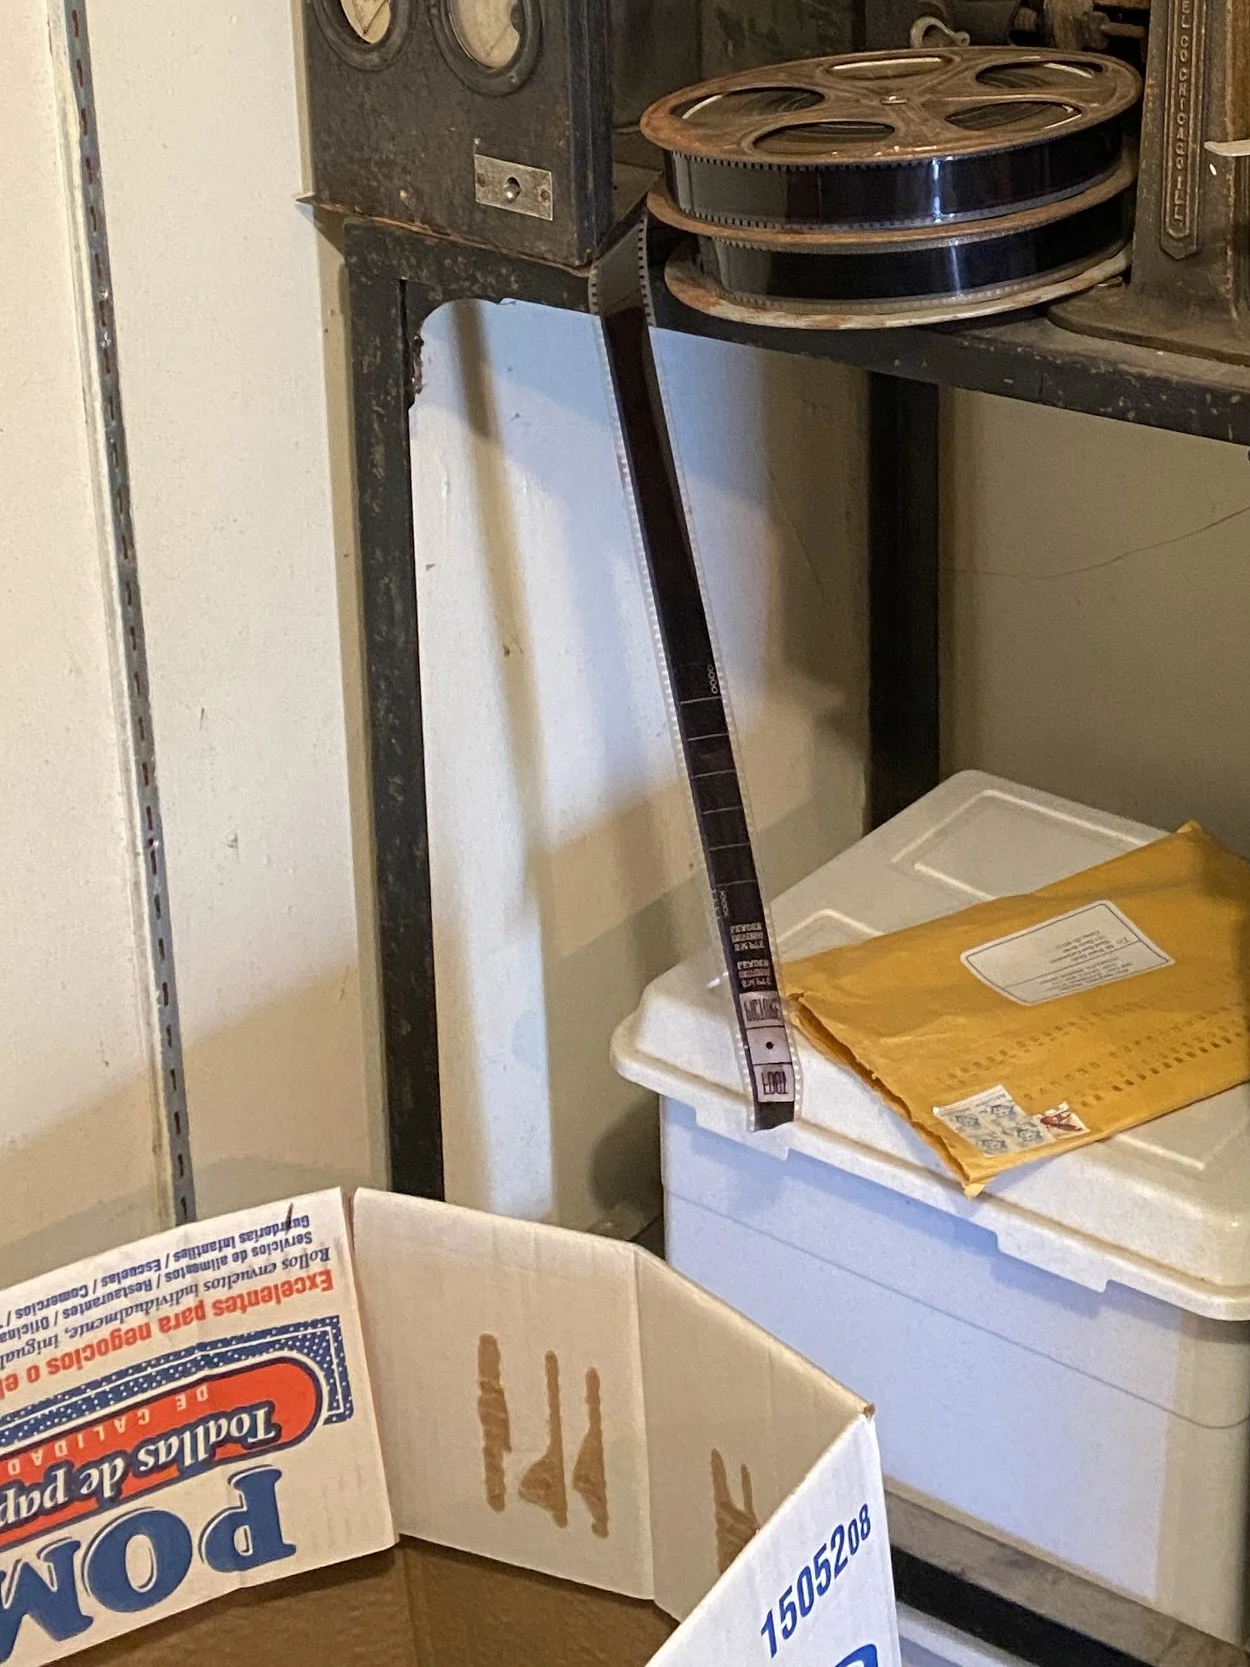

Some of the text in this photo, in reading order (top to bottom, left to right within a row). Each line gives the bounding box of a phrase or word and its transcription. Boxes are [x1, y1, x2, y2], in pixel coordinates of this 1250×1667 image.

[1175, 67, 1190, 170] CHICAGO
[231, 1250, 248, 1264] de
[251, 1231, 313, 1256] Servicios
[281, 1246, 331, 1271] Rollos
[101, 1258, 161, 1287] Escuelas
[165, 1254, 229, 1283] alimentos
[203, 1262, 277, 1292] envueltos
[14, 1284, 89, 1319] Comercios
[62, 1279, 153, 1319] Restaurantes
[64, 1283, 199, 1339] individualmente,
[211, 1269, 333, 1317] Excelentes
[158, 1298, 207, 1335] para
[45, 1321, 153, 1375] negocios
[26, 1364, 41, 1384] o
[7, 1387, 209, 1477] DE CALIDAD
[136, 1404, 277, 1474] Toallas
[79, 1456, 125, 1500] de
